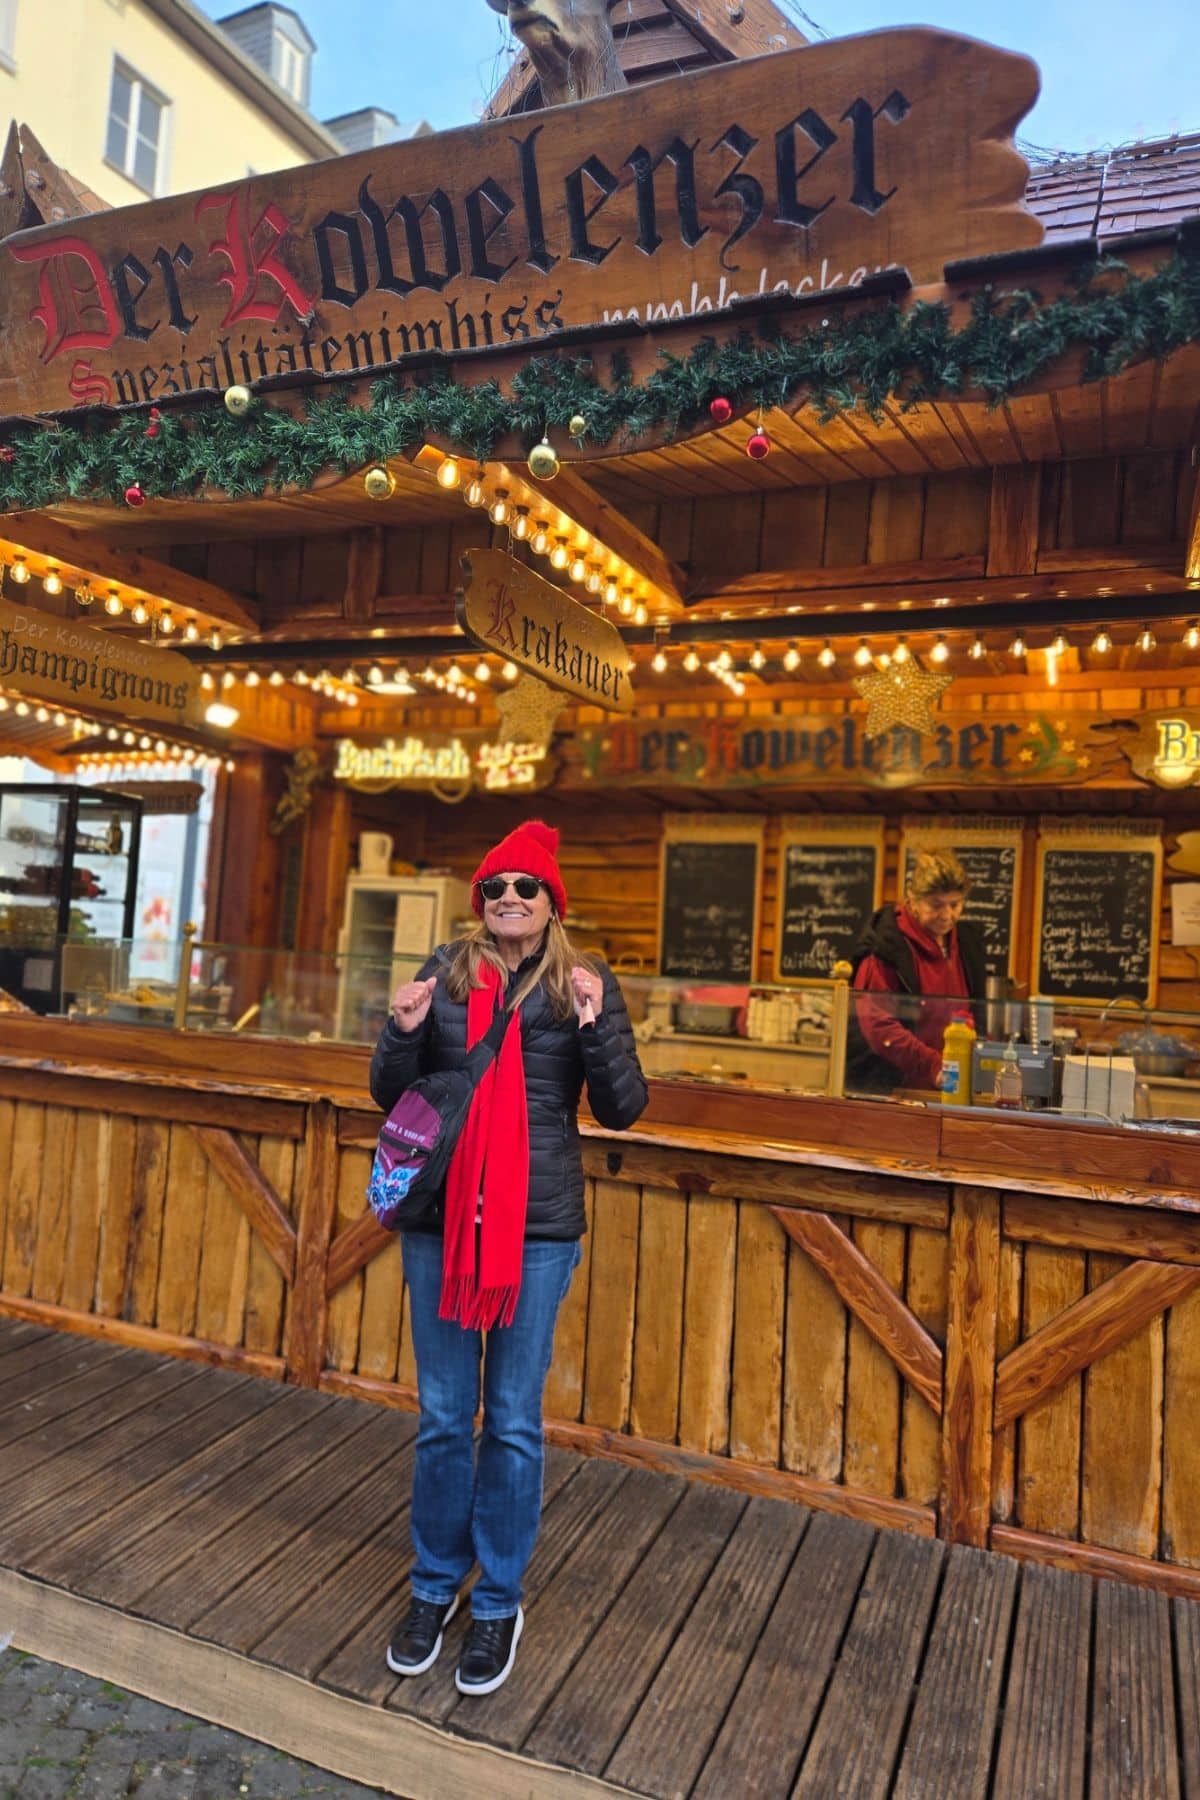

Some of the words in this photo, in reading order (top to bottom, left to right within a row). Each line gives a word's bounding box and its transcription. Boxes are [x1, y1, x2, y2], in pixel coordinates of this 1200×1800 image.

[9, 236, 199, 365] Der
[194, 88, 912, 330] Kowelenzer
[759, 258, 899, 296] lecke
[13, 615, 49, 639] Der
[484, 576, 624, 702] Krakauer
[611, 723, 689, 772] Der
